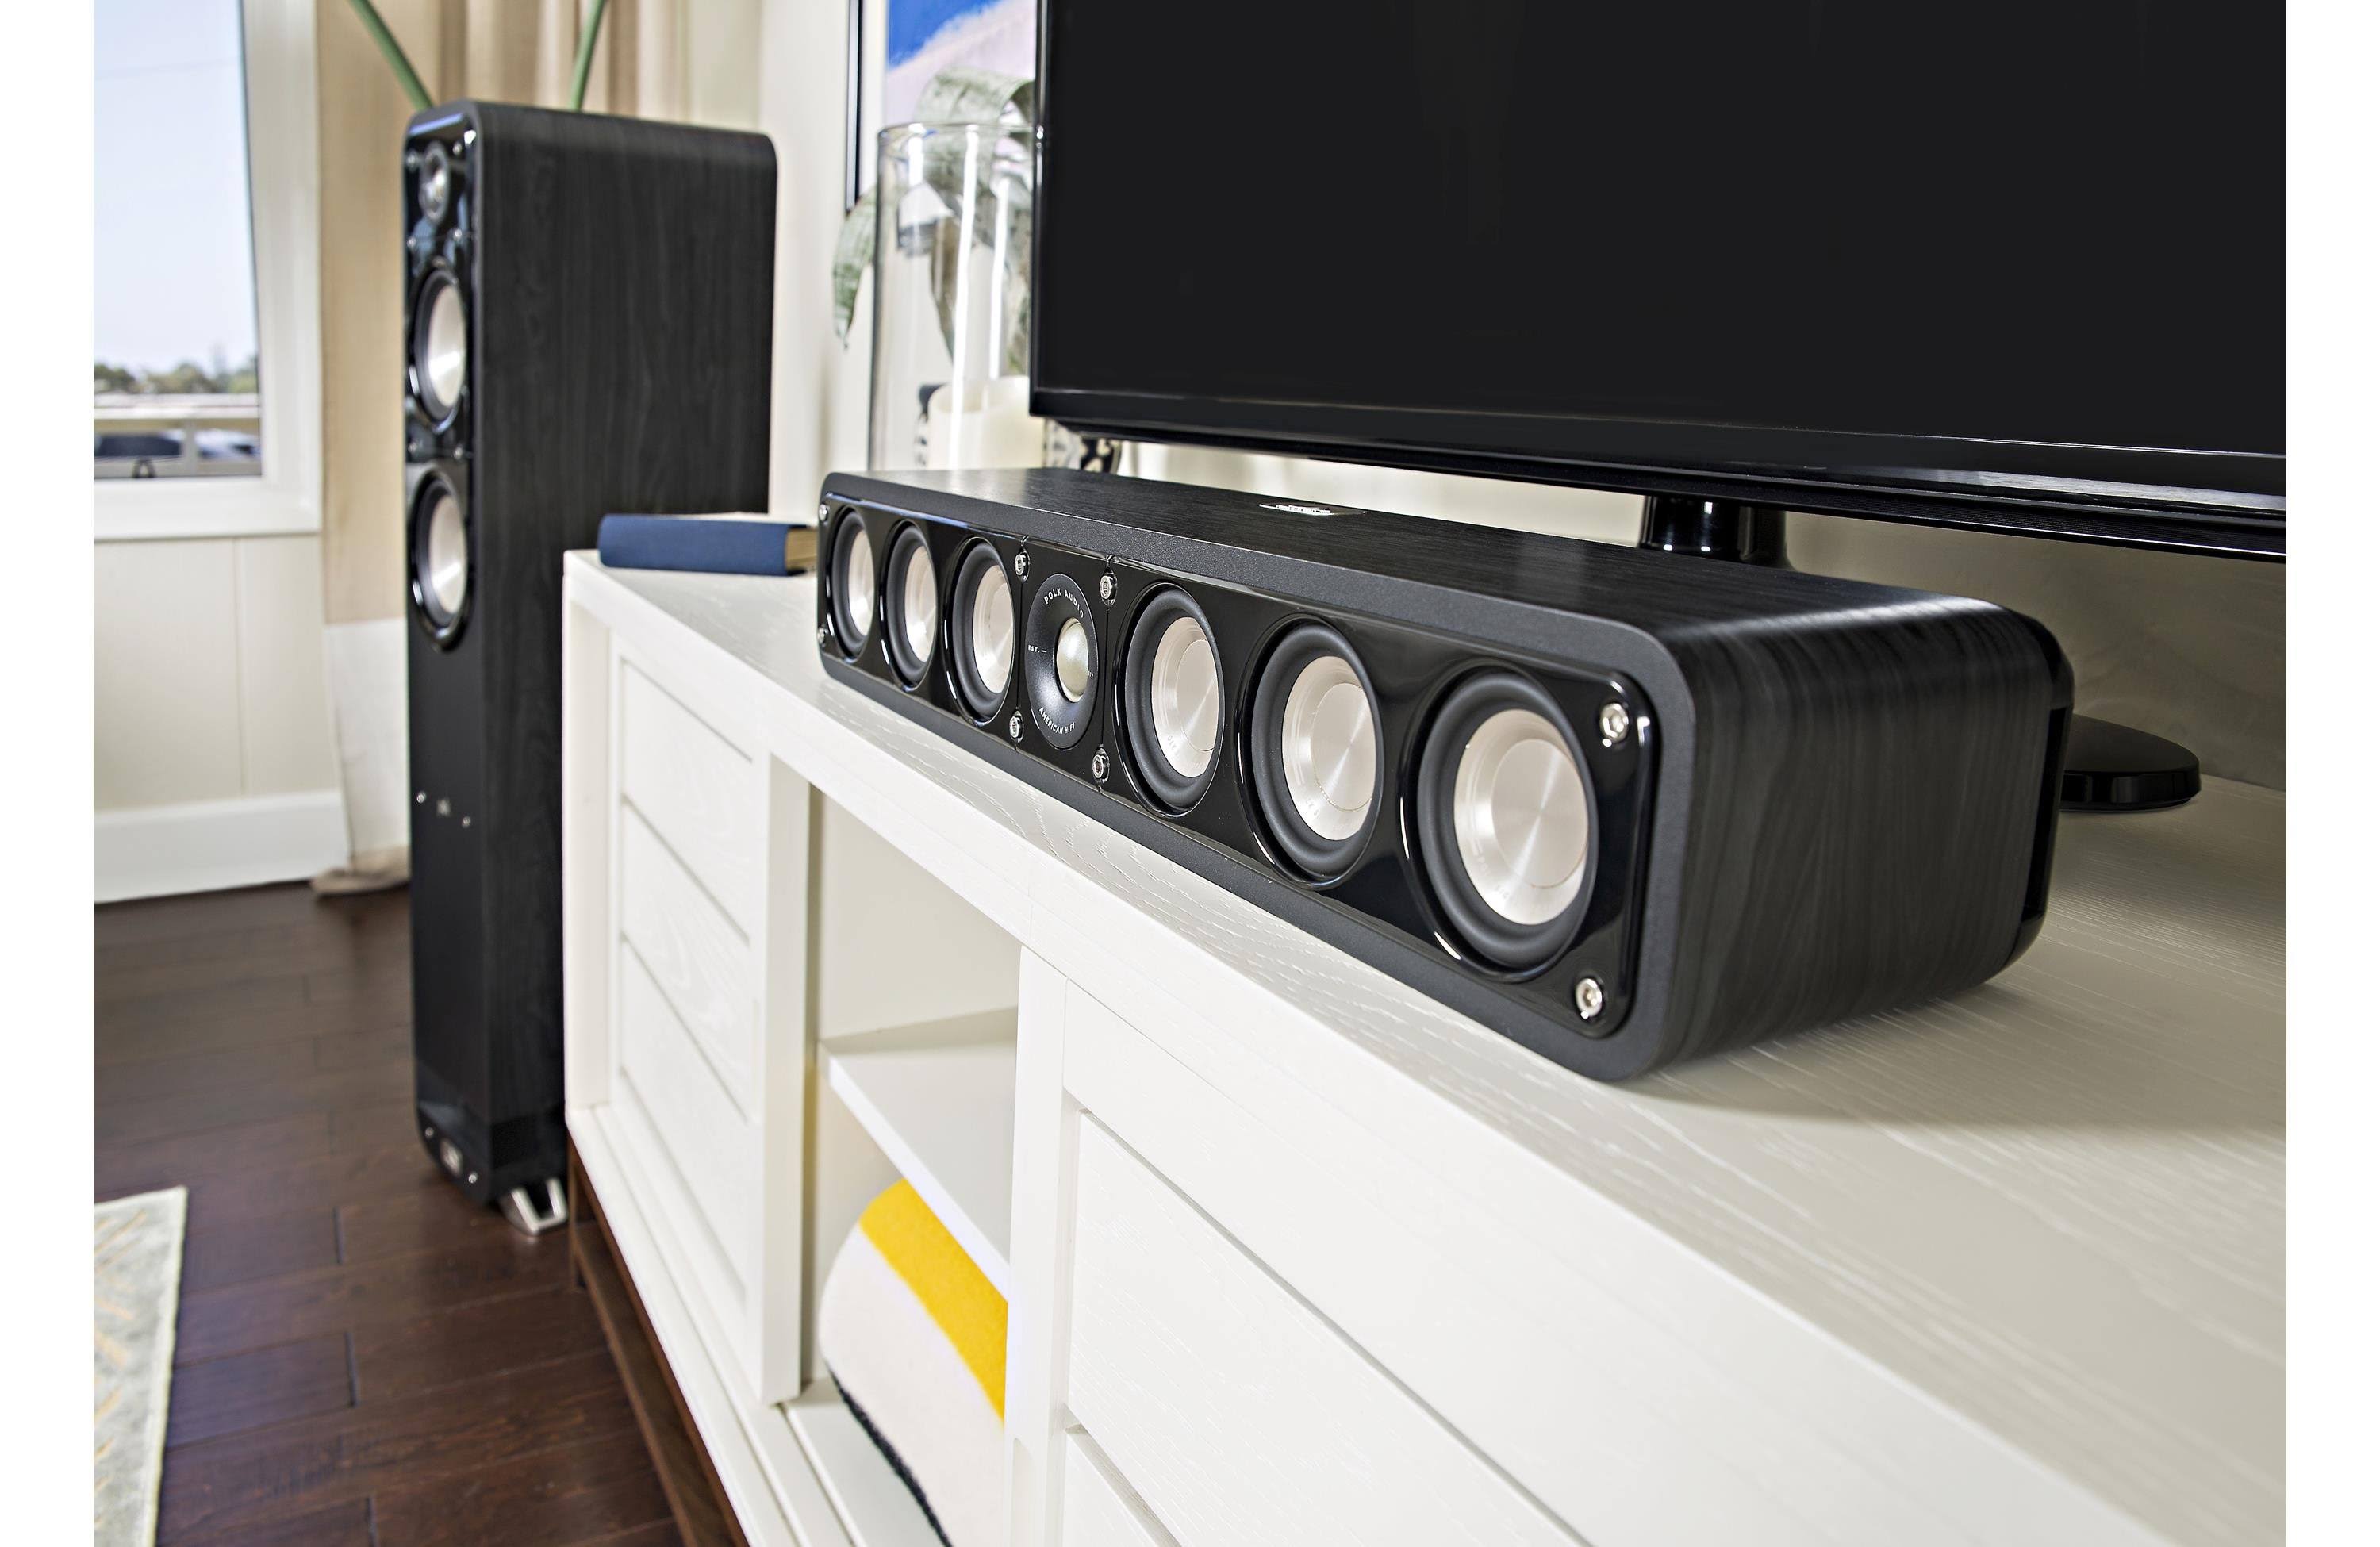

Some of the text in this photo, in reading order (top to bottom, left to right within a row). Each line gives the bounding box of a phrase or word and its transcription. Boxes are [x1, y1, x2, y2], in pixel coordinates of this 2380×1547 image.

[1044, 588, 1084, 618] POLK AUDIO
[1039, 707, 1075, 735] AMERICAN HIFI
